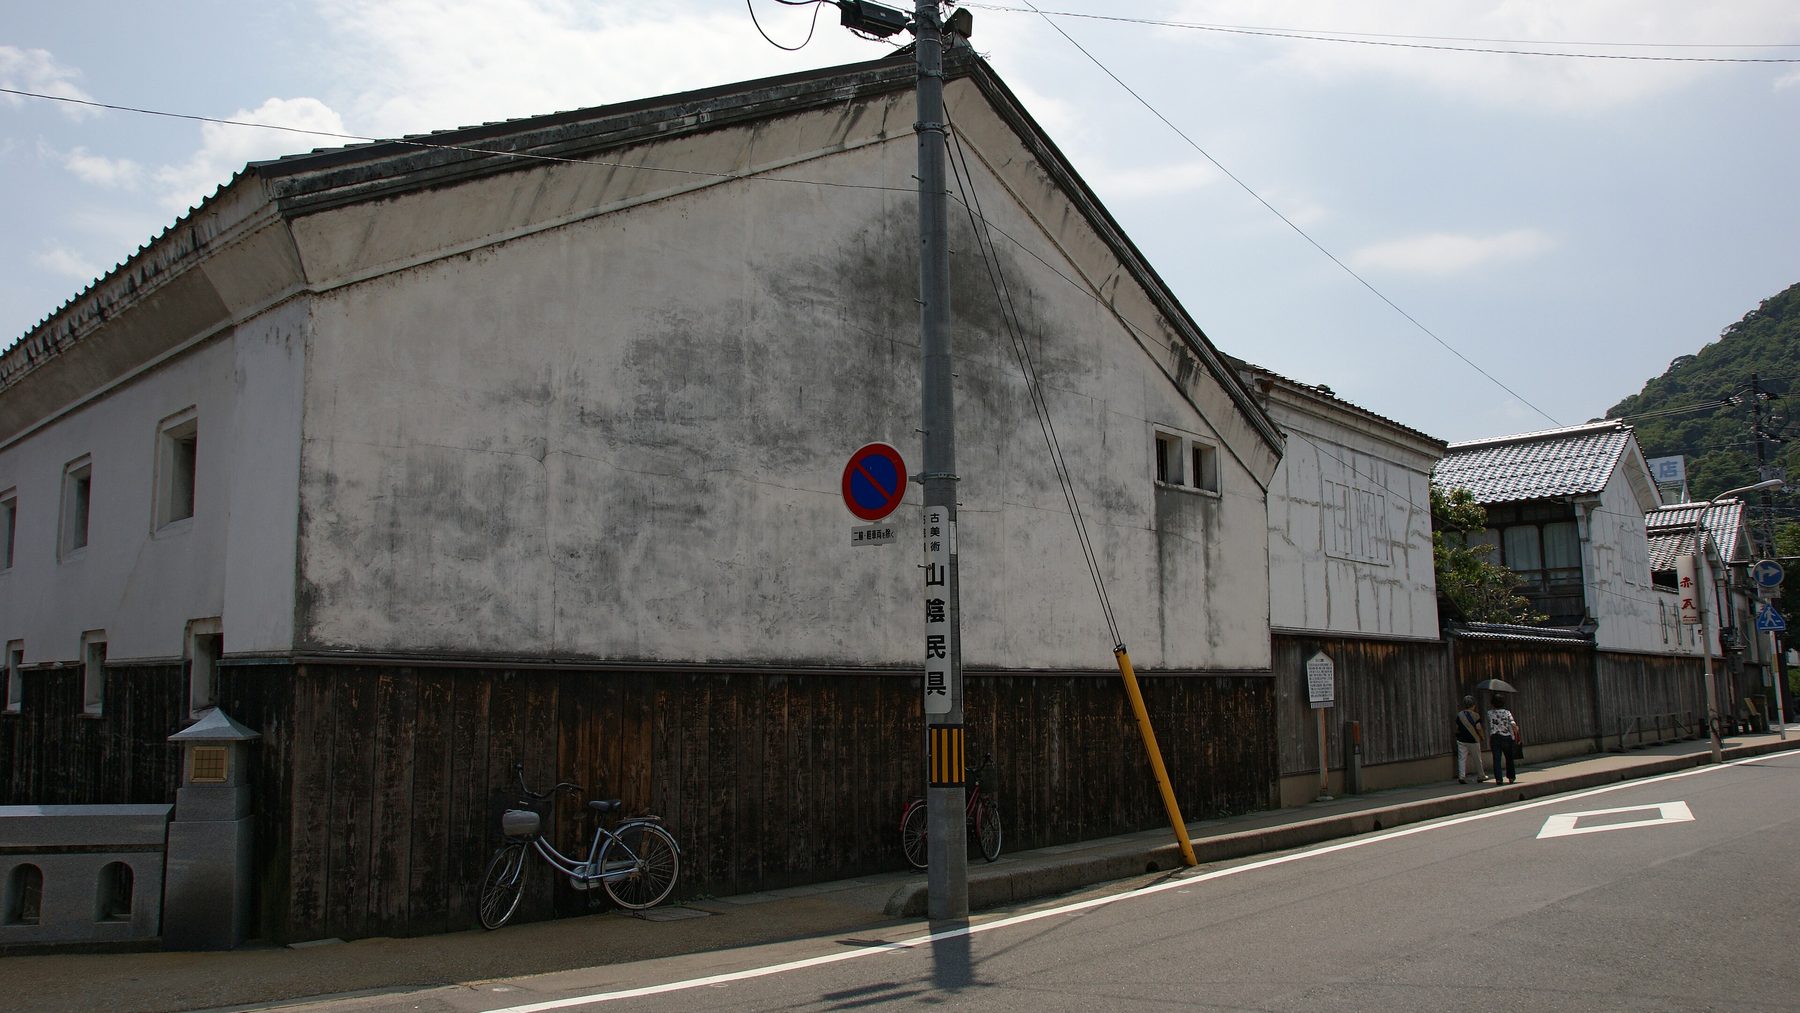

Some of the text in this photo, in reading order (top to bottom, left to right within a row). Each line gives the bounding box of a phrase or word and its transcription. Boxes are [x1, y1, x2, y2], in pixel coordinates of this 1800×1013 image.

[1651, 460, 1678, 479] 店
[930, 513, 941, 552] 古美術
[1680, 576, 1697, 610] 赤瓦
[925, 562, 947, 696] 山陰民具
